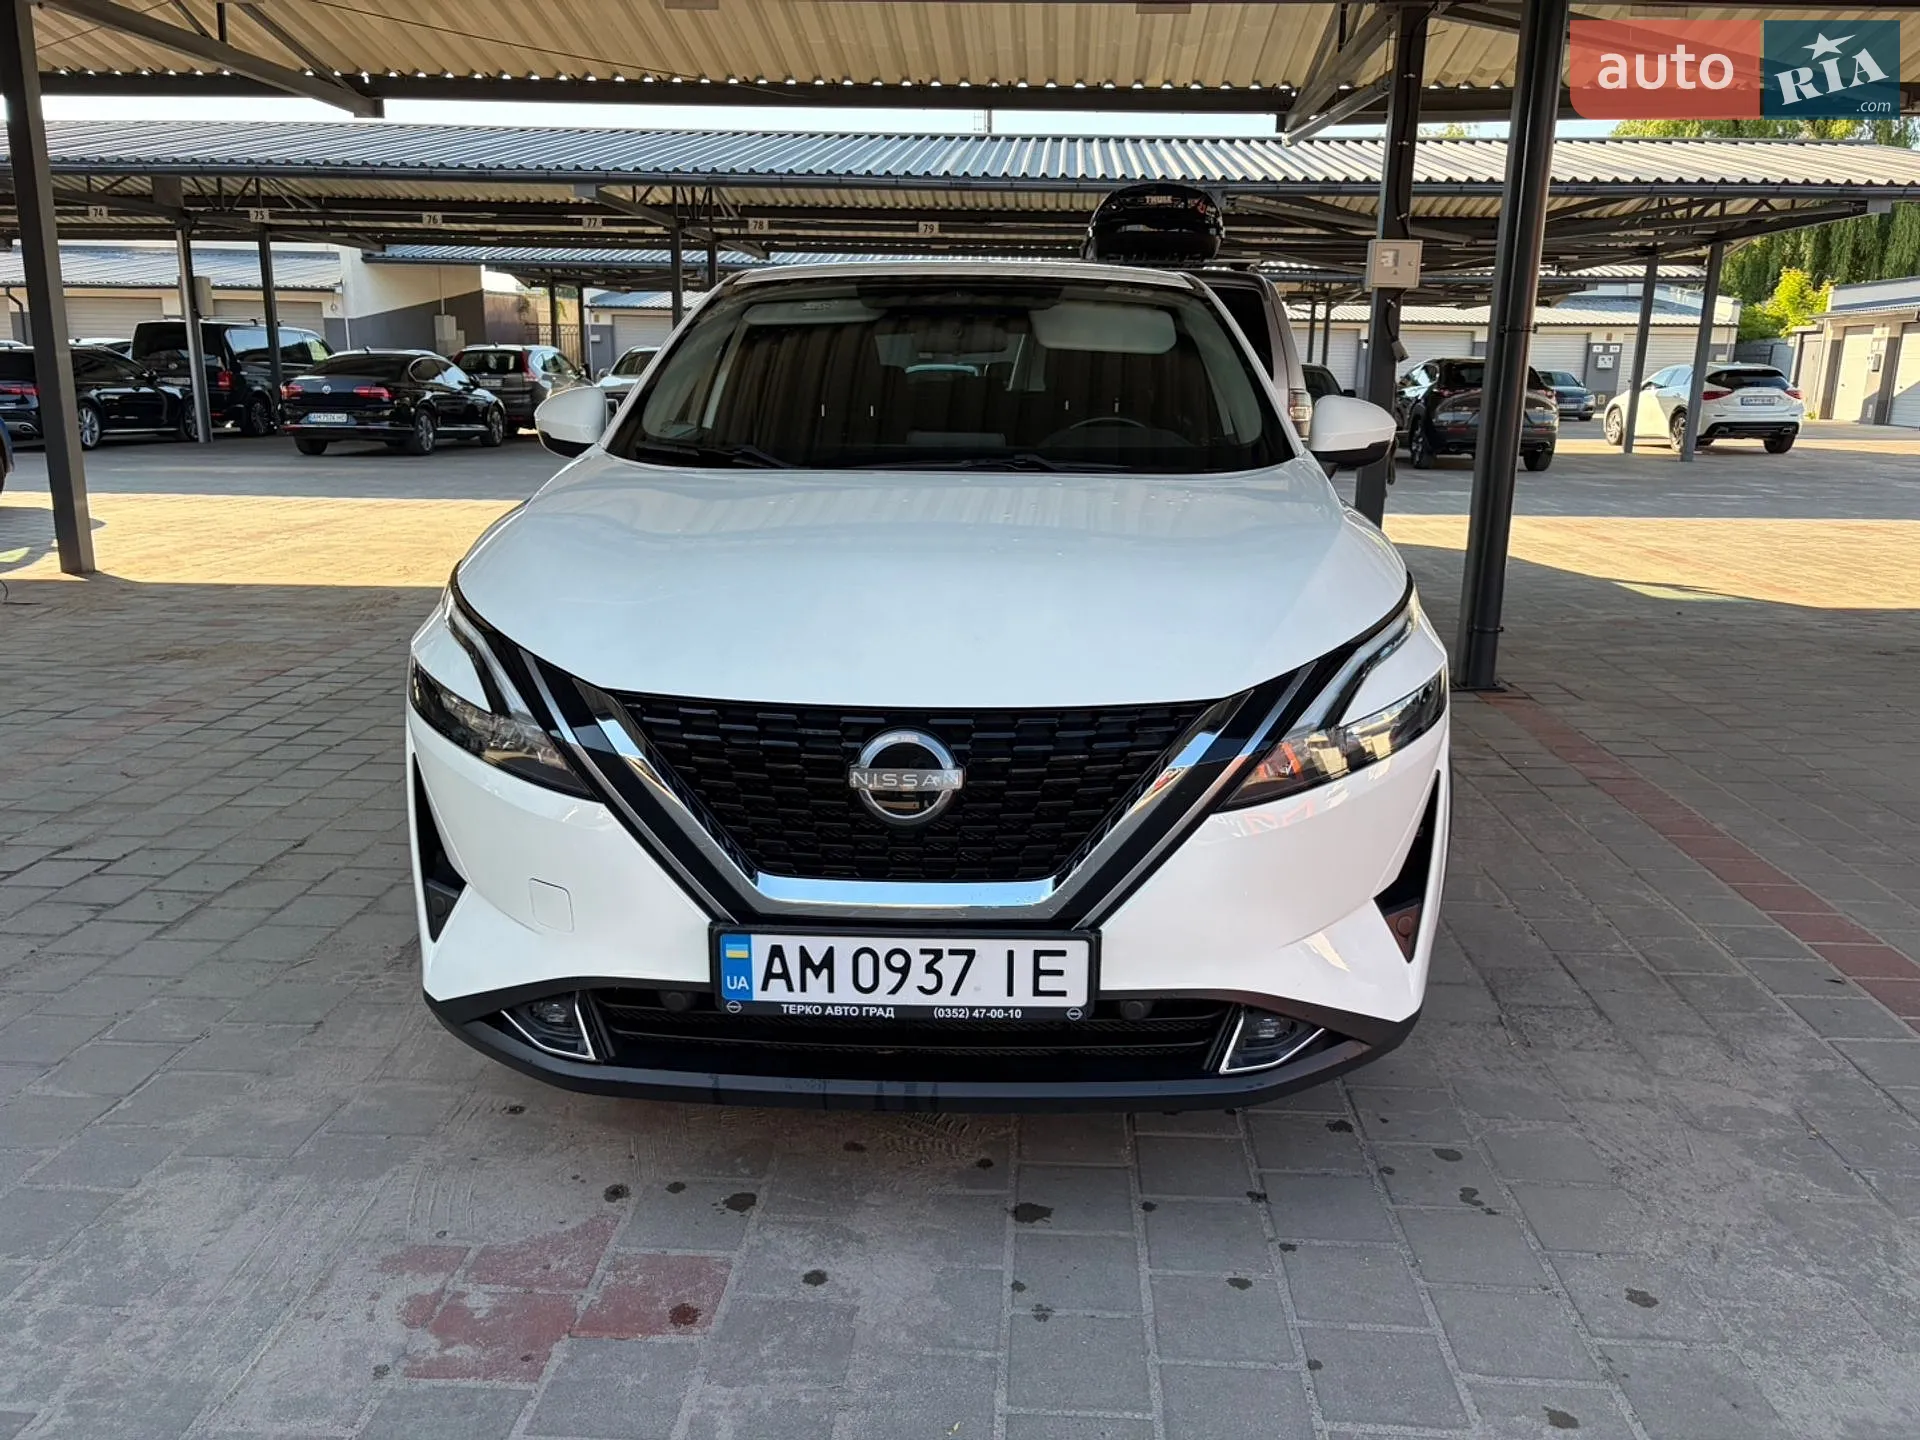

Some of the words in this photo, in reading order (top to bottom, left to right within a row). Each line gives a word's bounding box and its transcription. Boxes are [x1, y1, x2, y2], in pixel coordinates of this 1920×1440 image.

[93, 207, 104, 217] 74
[253, 210, 265, 220] 75
[426, 214, 438, 225] 76
[586, 217, 598, 228] 77
[752, 220, 764, 230] 78
[923, 224, 935, 234] 79
[852, 771, 960, 788] NISSAN
[760, 944, 835, 993] AM
[852, 946, 976, 996] 0937
[1006, 949, 1068, 997] IE
[726, 975, 750, 990] UA
[781, 1003, 823, 1016] ТЕРКО
[825, 1005, 859, 1017] АВТО
[862, 1006, 895, 1018] ГРАД
[933, 1007, 970, 1020] (0352)
[972, 1008, 1022, 1019] 47-00-10
